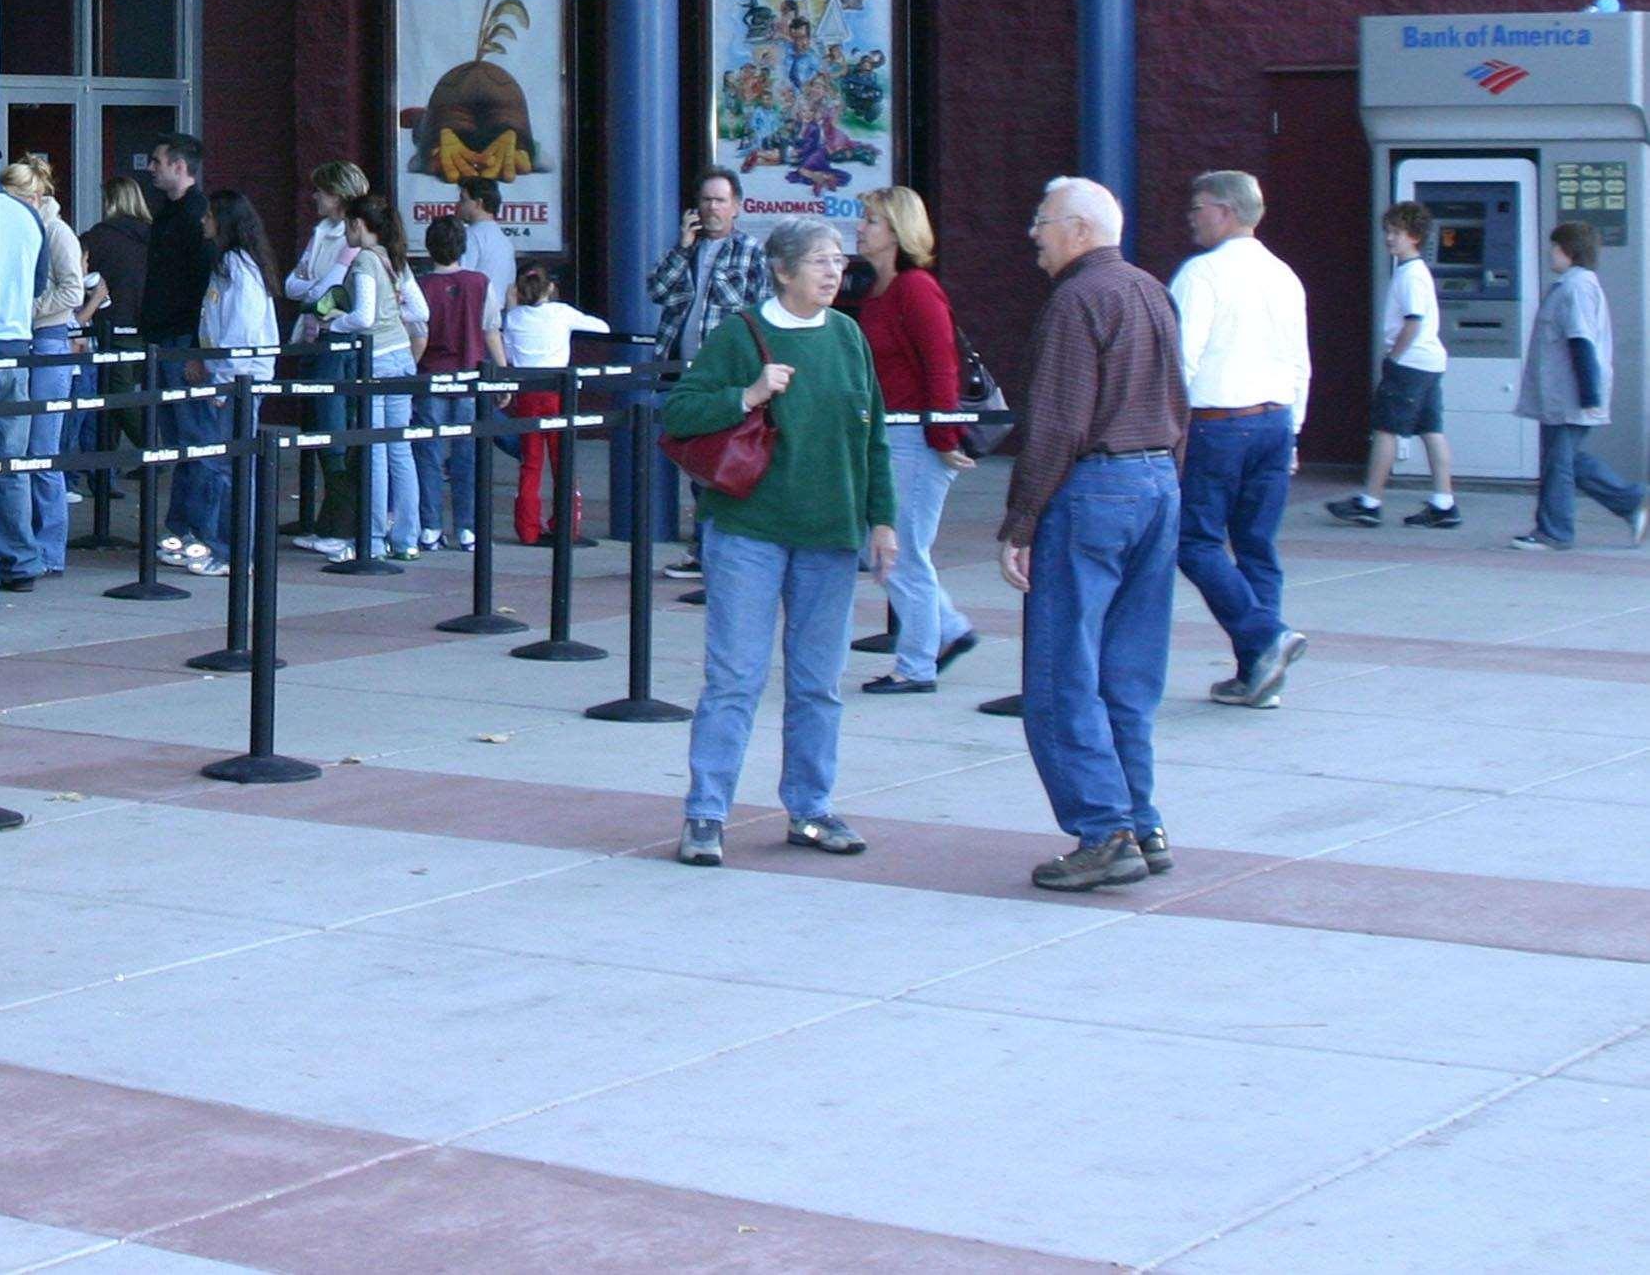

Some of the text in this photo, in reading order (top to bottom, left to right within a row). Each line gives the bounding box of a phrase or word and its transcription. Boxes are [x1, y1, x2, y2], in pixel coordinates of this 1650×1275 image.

[1403, 21, 1591, 48] Bank of America
[744, 198, 825, 214] GRANDMA'S
[502, 227, 531, 237] OV. 4
